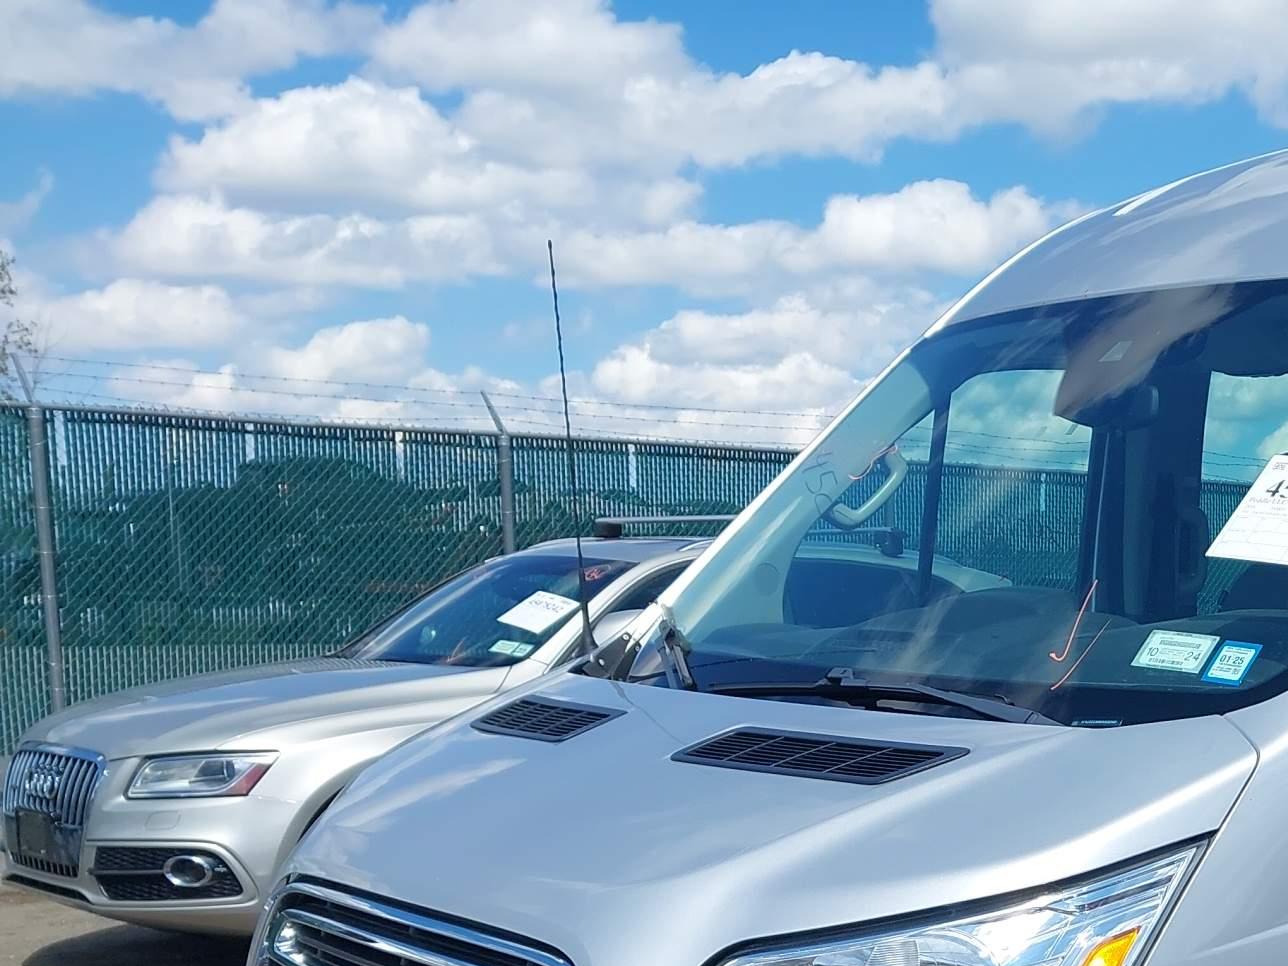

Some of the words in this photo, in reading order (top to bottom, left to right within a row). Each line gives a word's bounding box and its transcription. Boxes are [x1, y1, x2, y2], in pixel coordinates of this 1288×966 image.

[1146, 647, 1159, 657] 10
[1184, 652, 1202, 662] 24
[1219, 654, 1246, 665] 01-25
